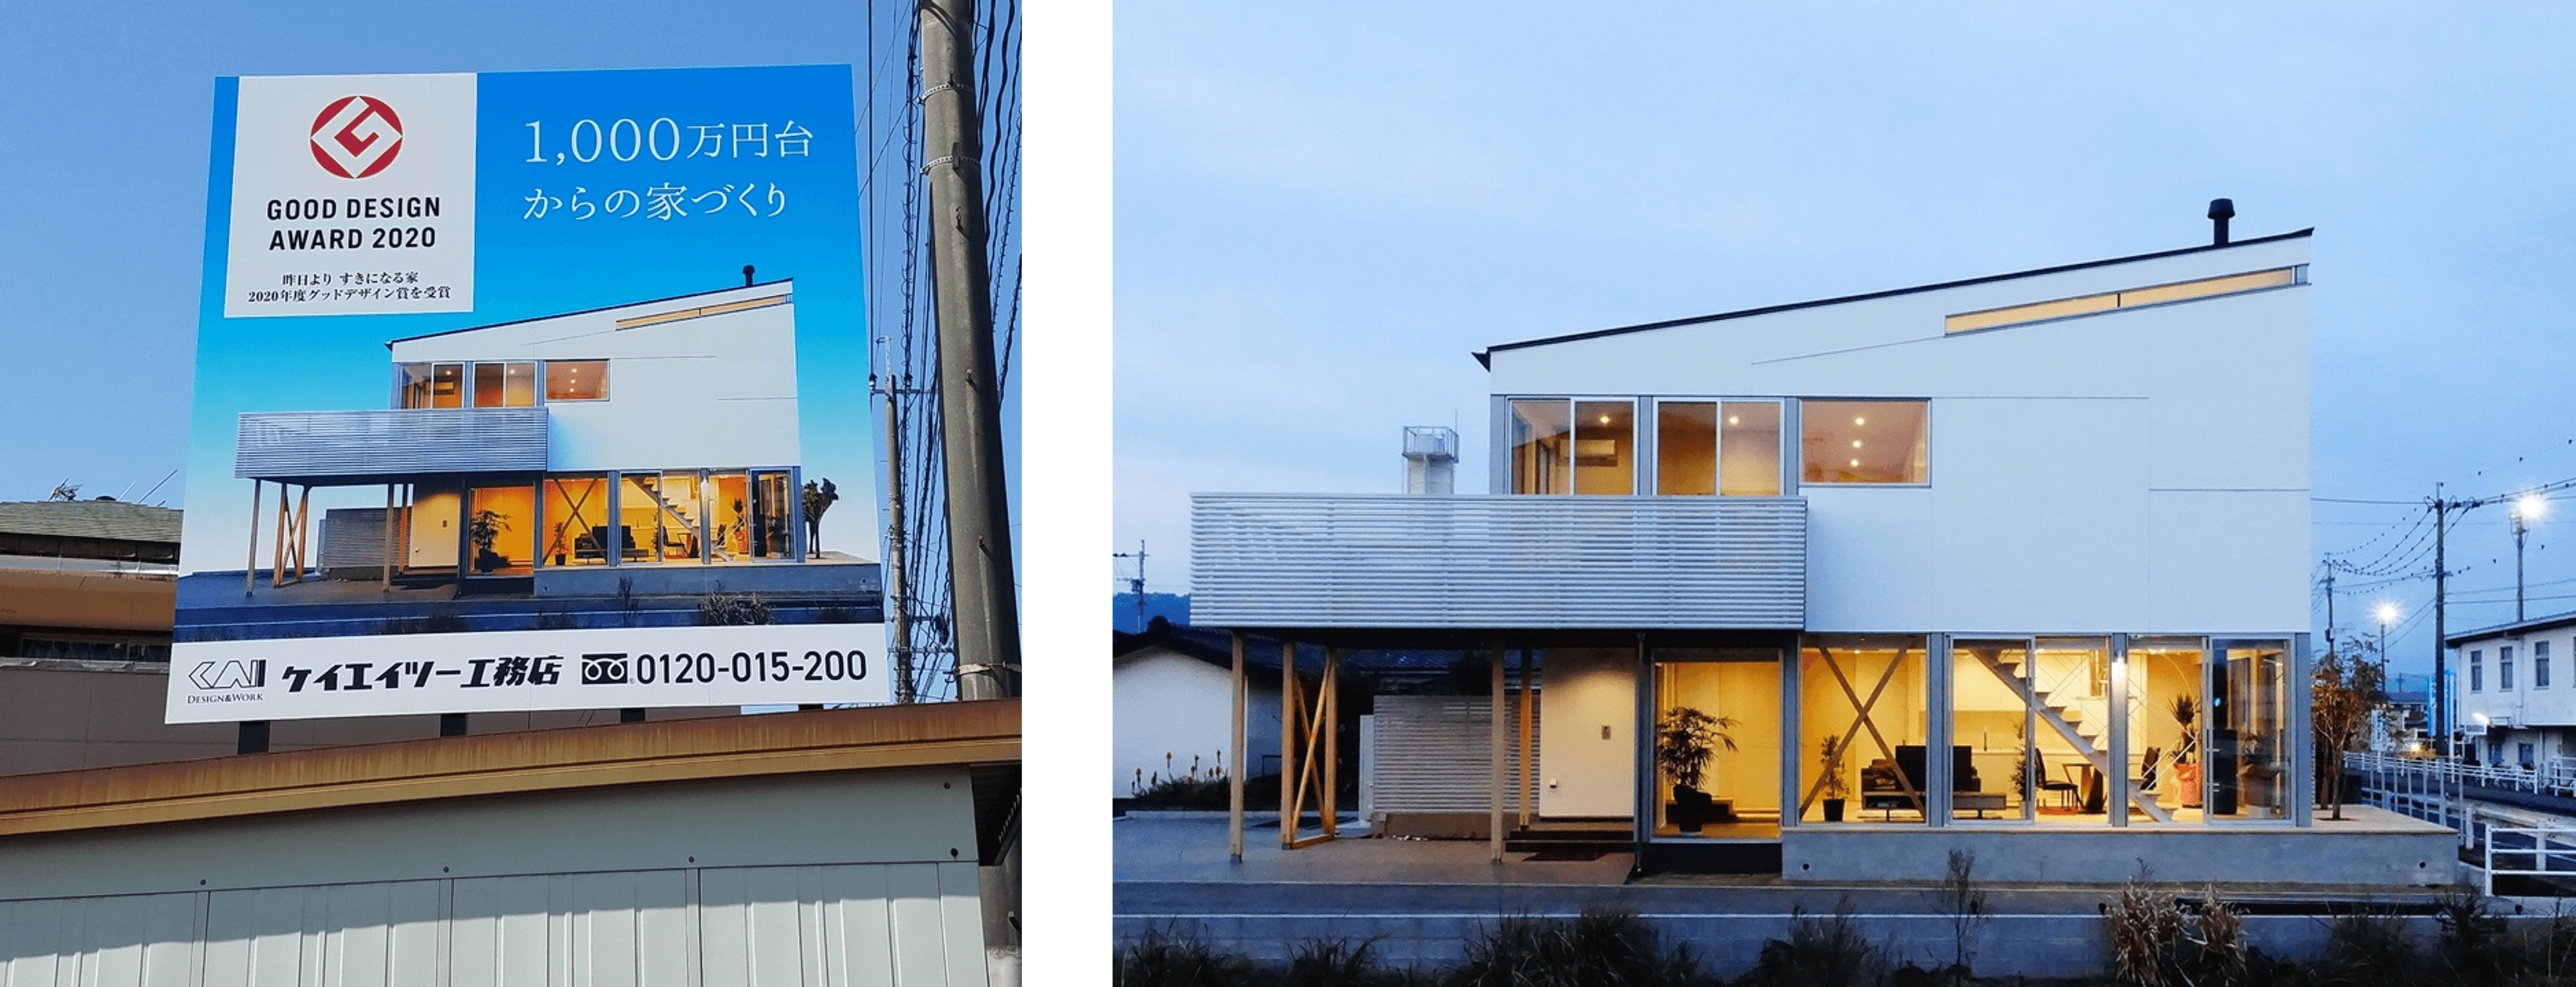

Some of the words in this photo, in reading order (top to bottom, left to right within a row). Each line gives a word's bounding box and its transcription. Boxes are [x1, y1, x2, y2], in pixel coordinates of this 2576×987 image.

[525, 117, 813, 166] 1,000万円台
[267, 198, 337, 220] GOOD
[346, 197, 440, 219] DESIGN
[524, 182, 786, 221] からの家づくり
[269, 228, 363, 250] AWARD
[372, 227, 436, 248] 2020
[281, 273, 332, 286] 昨日より
[339, 271, 419, 285] すきになる家
[248, 285, 451, 303] 2020年度グッドデザイン賞を受賞
[281, 654, 564, 693] ケイエイツー工務店
[636, 650, 868, 684] 0120-015-200
